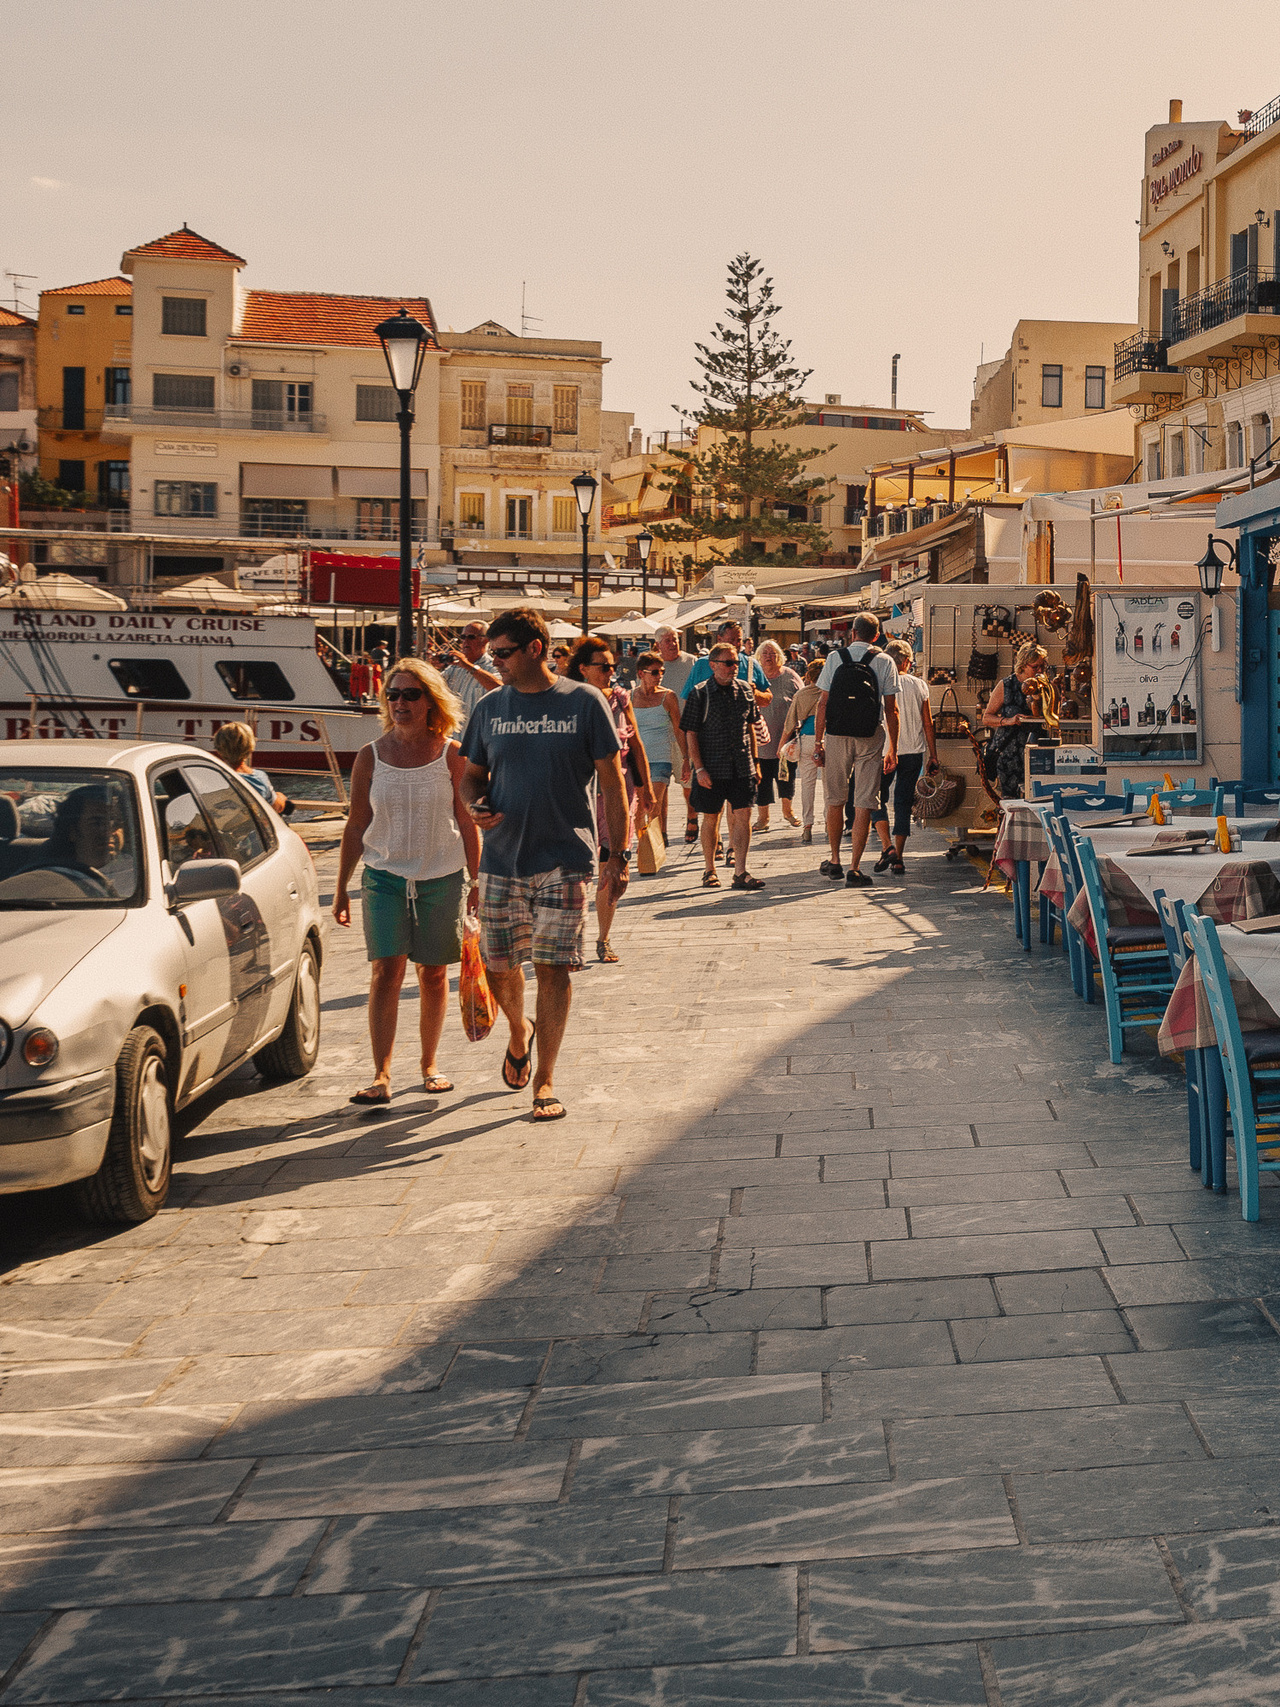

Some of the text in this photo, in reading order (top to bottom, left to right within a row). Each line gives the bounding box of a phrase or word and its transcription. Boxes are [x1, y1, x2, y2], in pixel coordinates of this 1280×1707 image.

[13, 613, 266, 632] ISLAND DAILY CRUISE
[1139, 674, 1159, 683] oliva
[5, 717, 126, 739] BOAT
[490, 714, 578, 736] Timberland
